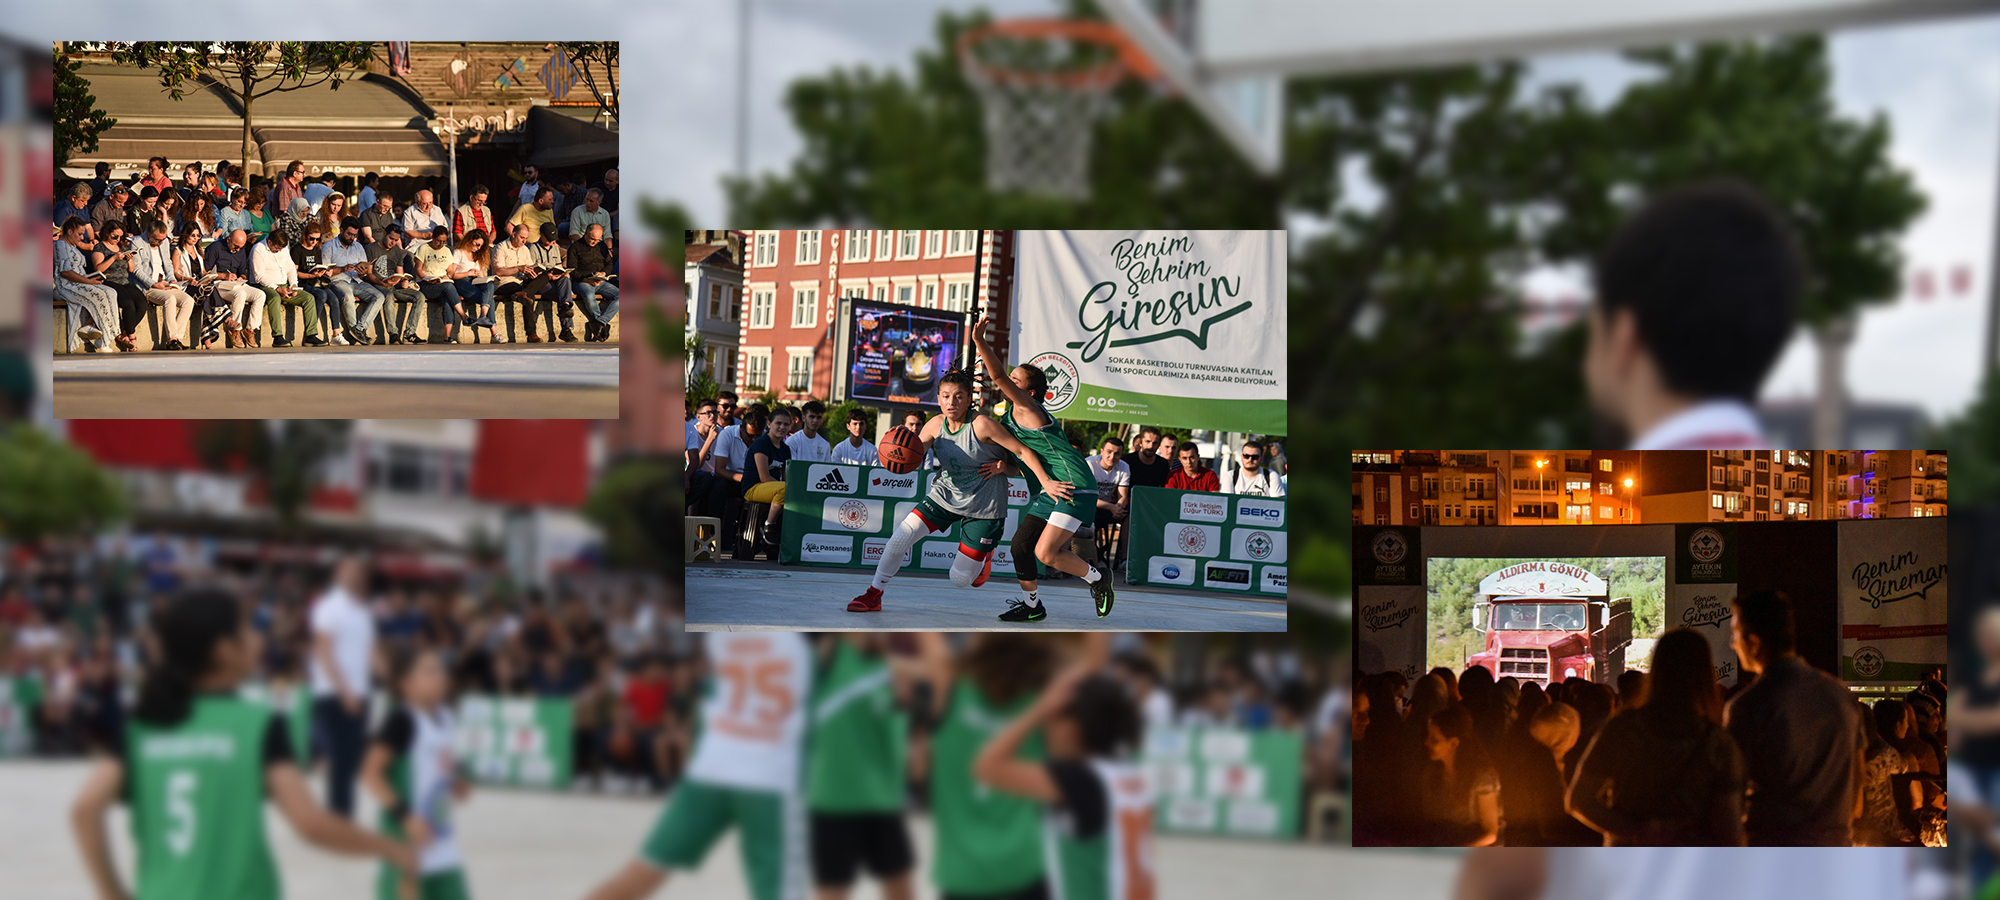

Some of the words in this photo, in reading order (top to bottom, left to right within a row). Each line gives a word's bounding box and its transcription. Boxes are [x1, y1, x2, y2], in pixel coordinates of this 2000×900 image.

[322, 165, 333, 173] Ali
[334, 165, 365, 173] Osman
[380, 165, 409, 174] Ulusoy
[1110, 236, 1194, 270] Benim
[1127, 256, 1211, 299] Şehrim
[1078, 275, 1241, 363] Giresun
[1108, 356, 1135, 365] SOKAK
[1136, 358, 1184, 369] BASKETBOLU
[1185, 363, 1239, 373] TURNUVASINA
[1240, 367, 1273, 376] KATILAN
[1123, 368, 1189, 380] SPORCULARIMIZA
[1190, 373, 1233, 383] BAŞARILAR
[1234, 377, 1279, 386] DİLİYORUM.
[815, 481, 850, 491] adidas
[882, 478, 914, 489] arçelik
[1240, 507, 1280, 518] BEKO
[924, 550, 946, 558] Hakan
[1496, 562, 1546, 582] ALDIRMA
[1549, 563, 1589, 583] GÖNÜL
[1852, 551, 1918, 590] Benim
[1361, 600, 1398, 622] Benim
[1693, 595, 1718, 606] Benim
[1370, 606, 1420, 632] Sinemam
[1682, 606, 1731, 629] Giresun
[165, 772, 199, 855] 5
